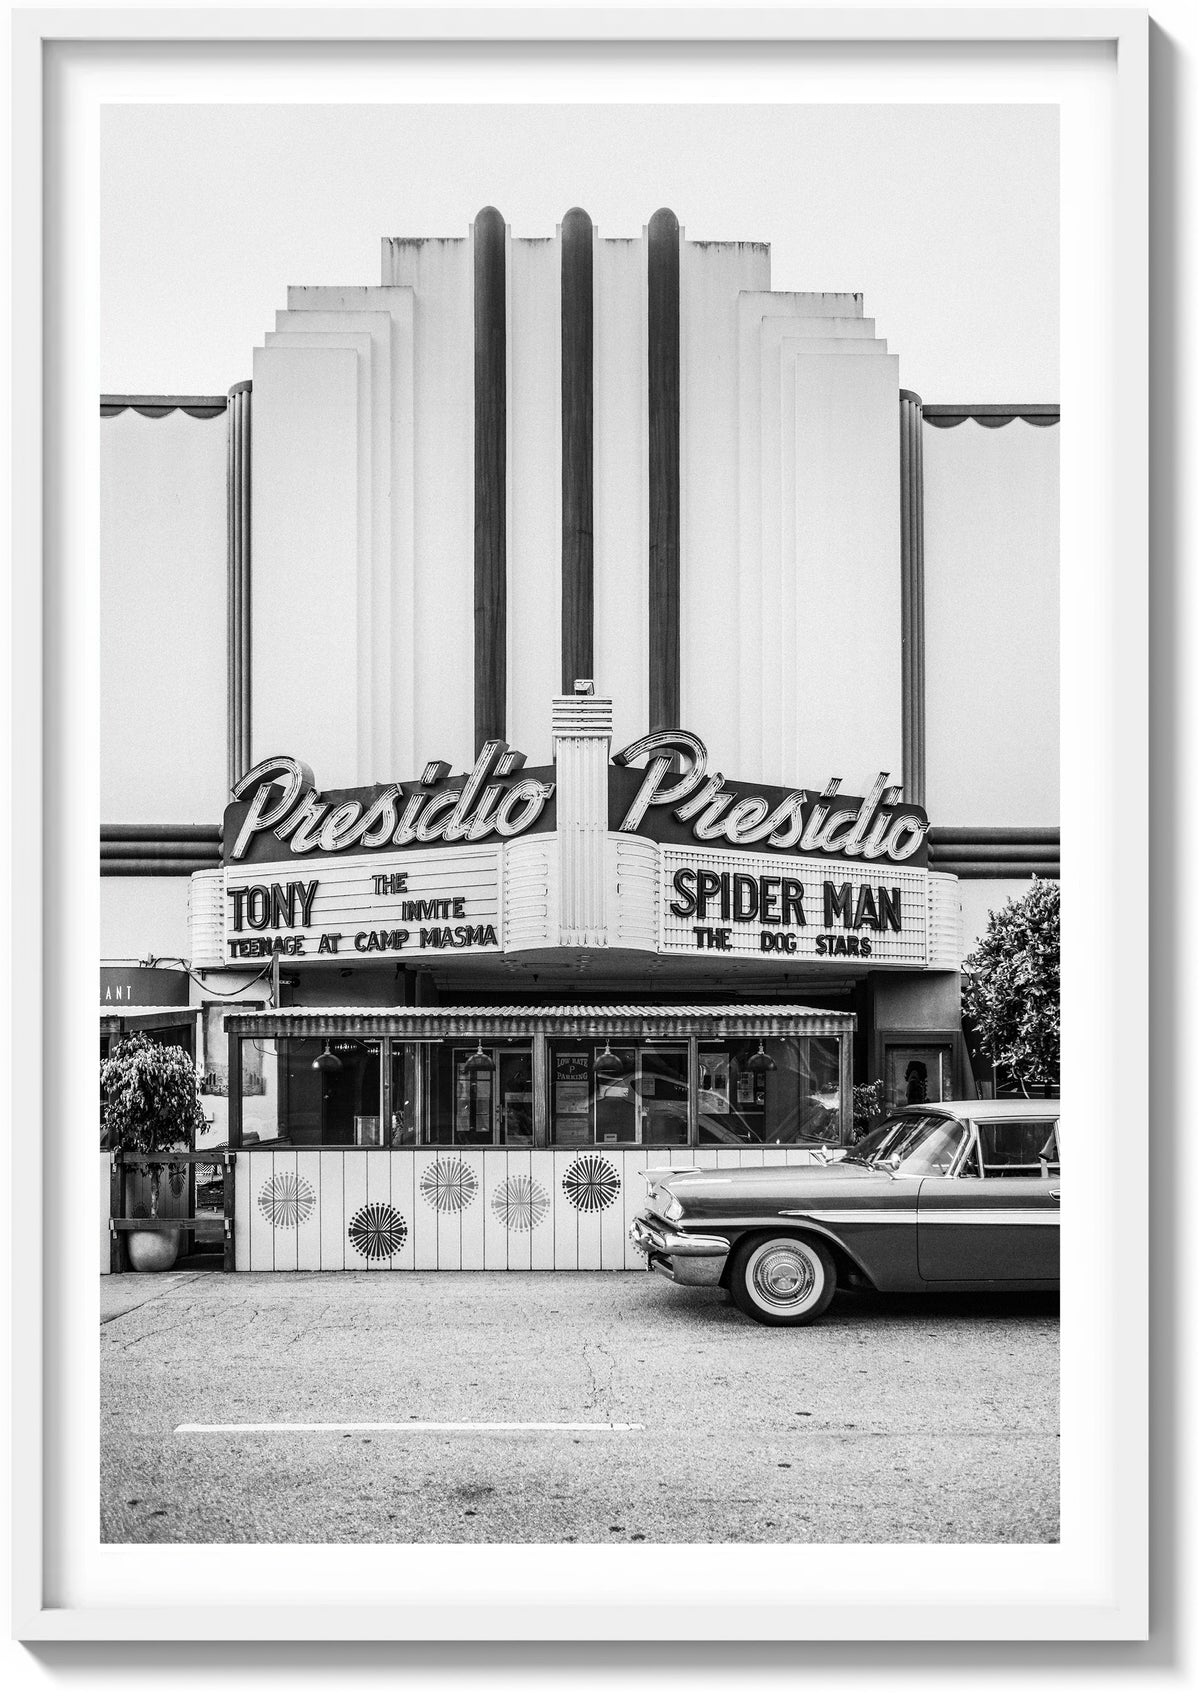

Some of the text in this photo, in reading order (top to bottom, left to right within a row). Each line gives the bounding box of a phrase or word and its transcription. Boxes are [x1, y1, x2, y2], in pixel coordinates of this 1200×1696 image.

[230, 739, 556, 860] Presidio
[611, 729, 931, 862] Presidio
[371, 872, 408, 895] THE
[670, 867, 900, 932] SPIDER MAN
[227, 879, 319, 932] TONY
[401, 896, 465, 921] INVITE
[227, 924, 498, 958] TEENAGE AT CAMP MIASMA
[693, 926, 872, 956] THE DOG STARS
[100, 985, 132, 1000] ANT
